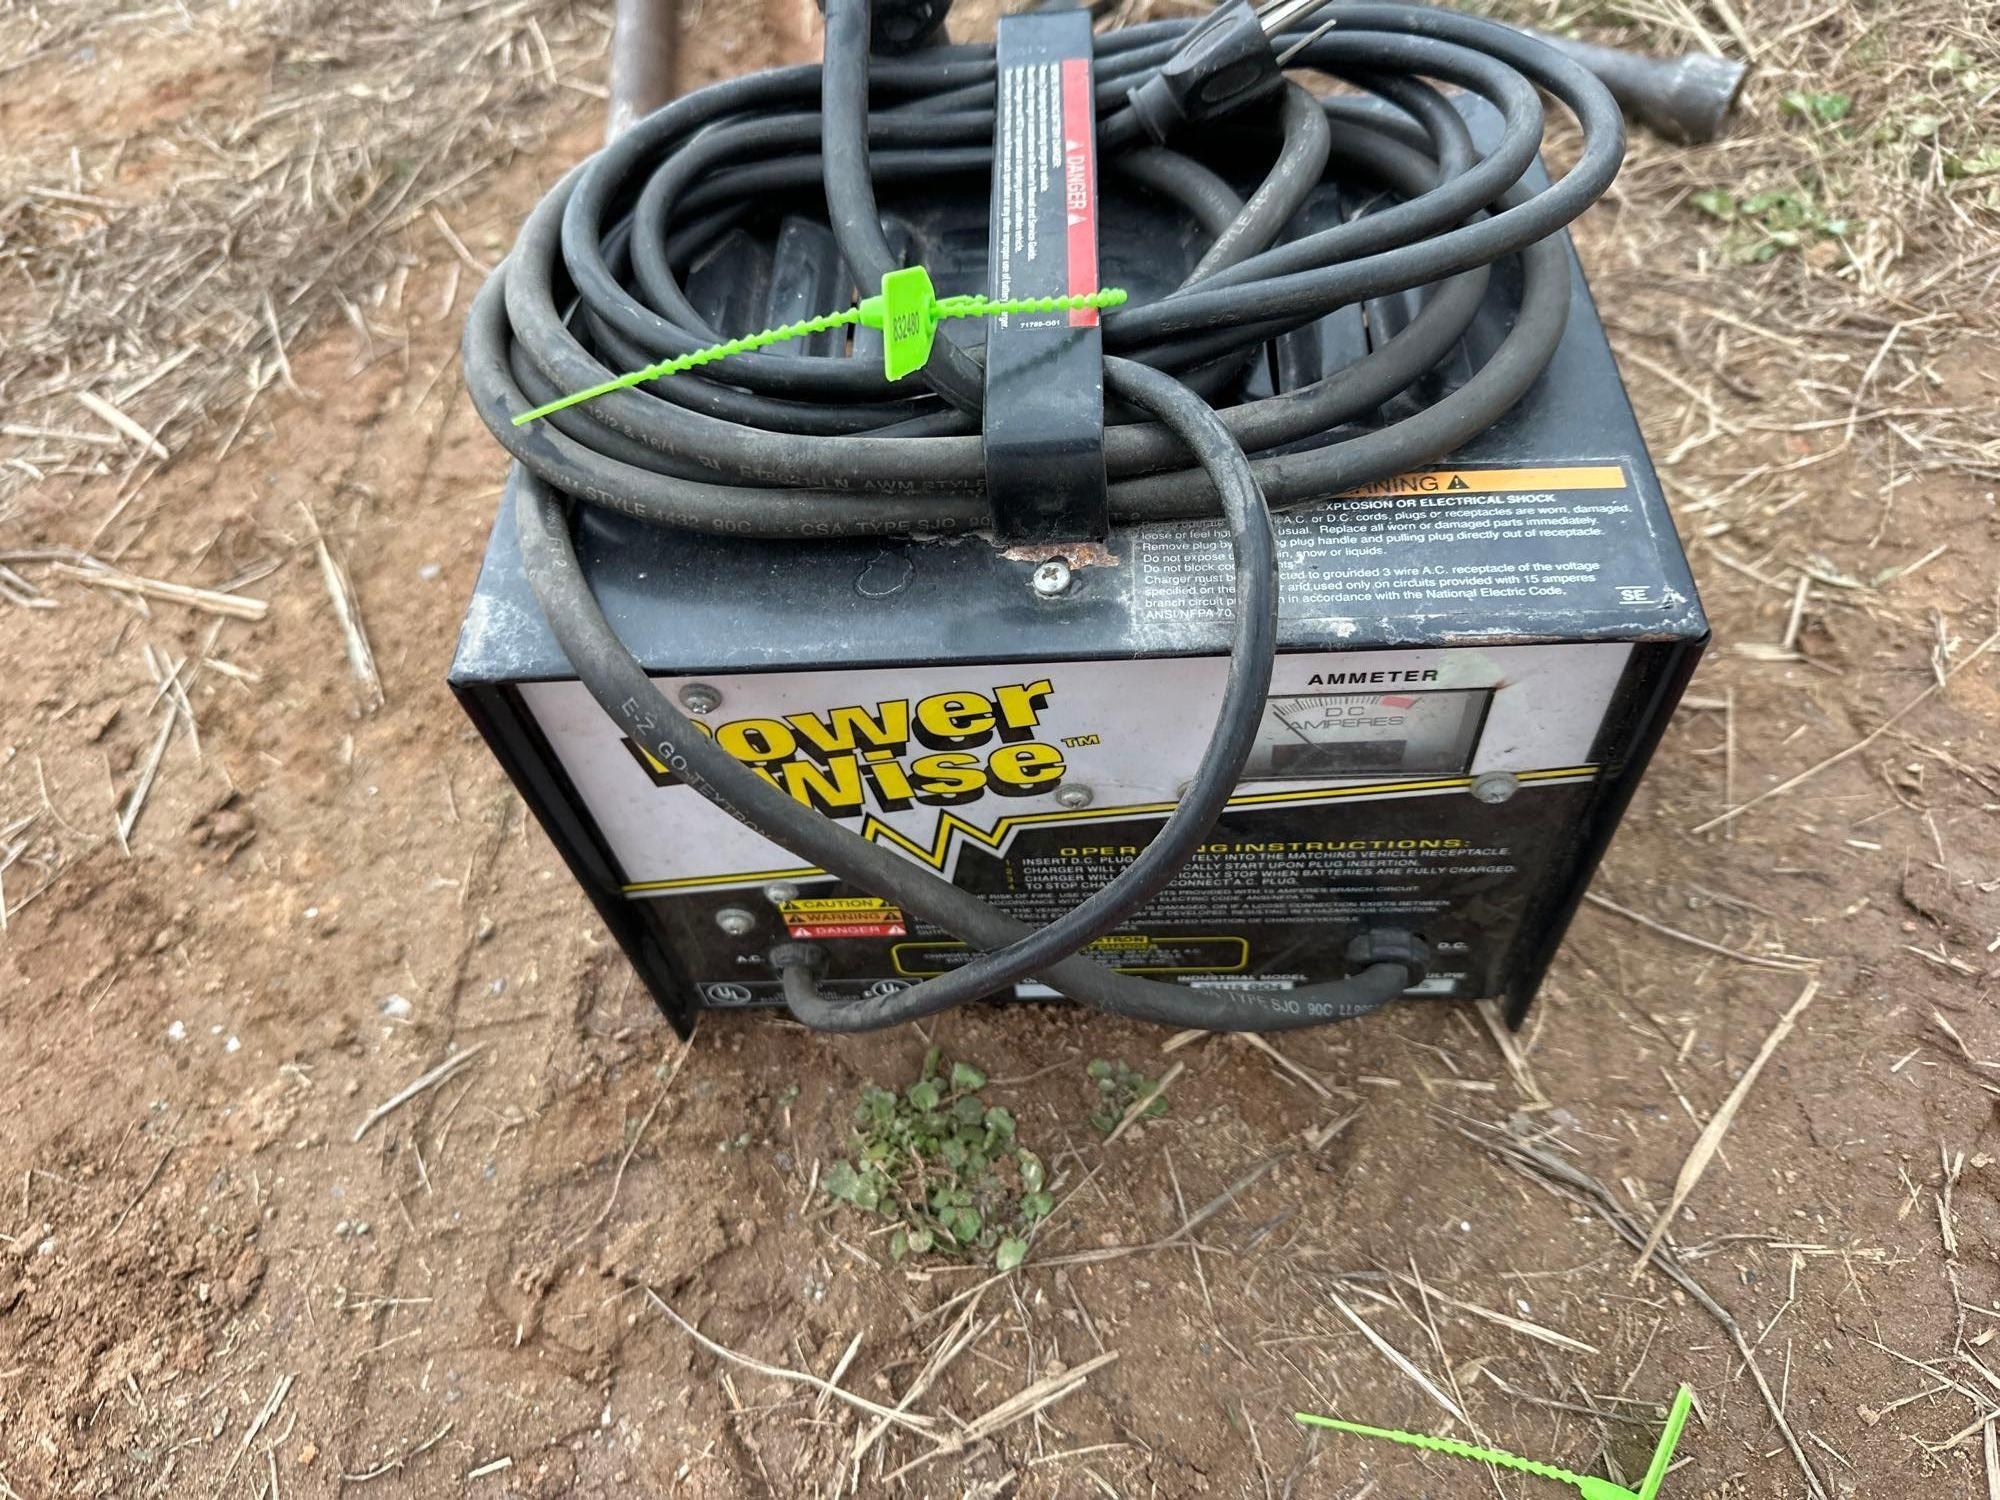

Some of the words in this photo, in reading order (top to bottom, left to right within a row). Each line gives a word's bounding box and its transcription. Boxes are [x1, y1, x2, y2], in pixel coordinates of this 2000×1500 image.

[1067, 156, 1086, 211] DANGER
[1397, 499, 1416, 508] OR
[1420, 496, 1504, 508] ELECTRICAL
[1507, 494, 1556, 504] SHOCK
[585, 487, 646, 515] STYLE
[800, 521, 842, 535] CSA
[856, 519, 911, 533] TYPE
[1284, 516, 1307, 524] A.C.
[1311, 515, 1323, 523] or
[1327, 514, 1352, 522] D.C.
[1395, 511, 1426, 522] plugs
[1445, 507, 1513, 520] receptacles
[1515, 507, 1535, 515] are
[1142, 532, 1171, 540] loose
[1176, 531, 1187, 539] or
[1189, 530, 1210, 539] feel
[1320, 524, 1366, 535] Replace
[1370, 523, 1384, 532] all
[1388, 523, 1416, 531] worn
[1419, 522, 1431, 530] or
[1434, 518, 1490, 530] damaged
[1494, 517, 1524, 528] parts
[1525, 515, 1599, 527] immediately.
[1143, 542, 1189, 551] Remove
[1192, 541, 1217, 552] plug
[1220, 540, 1233, 549] by
[1290, 536, 1315, 547] plug
[1318, 534, 1357, 545] handle
[1361, 534, 1383, 544] and
[1386, 533, 1425, 545] pulling
[1428, 532, 1453, 543] plug
[1457, 529, 1499, 540] directly
[1502, 529, 1522, 538] out
[1524, 528, 1536, 537] of
[1143, 554, 1159, 563] Do
[1162, 554, 1180, 562] not
[1184, 553, 1226, 563] expose
[1296, 549, 1327, 558] snow
[1330, 548, 1342, 556] or
[1346, 545, 1387, 557] liquids.
[1143, 564, 1159, 573] Do
[1163, 564, 1181, 572] not
[1184, 562, 1215, 572] block
[1145, 576, 1191, 587] Charger
[1195, 574, 1223, 584] must
[1309, 570, 1320, 579] to
[1323, 568, 1379, 581] grounded
[1382, 568, 1391, 576] 3
[1394, 567, 1419, 576] wire
[1422, 565, 1448, 575] A.C.
[1452, 563, 1515, 575] receptacle
[1518, 562, 1530, 572] of
[1533, 562, 1552, 572] the
[1555, 561, 1600, 572] voltage
[1145, 586, 1196, 597] specified
[1199, 586, 1214, 594] on
[1217, 585, 1236, 594] the
[1288, 581, 1310, 591] and
[1346, 580, 1371, 591] only
[1375, 580, 1390, 588] on
[1393, 578, 1436, 588] circuits
[1439, 575, 1492, 588] provided
[1495, 574, 1520, 584] with
[1524, 574, 1540, 584] 15
[1542, 574, 1596, 586] amperes
[1145, 598, 1185, 608] branch
[1189, 598, 1223, 607] circuit
[1288, 594, 1298, 603] in
[1302, 592, 1371, 603] accordance
[1375, 591, 1400, 601] with
[1403, 590, 1423, 600] the
[1426, 588, 1477, 599] National
[1481, 587, 1533, 598] Electric
[1621, 590, 1648, 601] SE
[1308, 670, 1438, 686] AMMETER
[1287, 716, 1404, 731] AMPERES
[621, 697, 658, 736] E-Z
[658, 741, 687, 771] GO
[1063, 735, 1099, 749] TM
[748, 741, 1067, 816] Wise
[1235, 839, 1471, 853] INSTRUCTIONS:
[1022, 857, 1067, 866] INSERT
[1071, 857, 1097, 865] D.C.
[1100, 856, 1135, 864] PLUG
[1224, 853, 1255, 861] INTO
[1259, 852, 1284, 860] THE
[1287, 850, 1356, 860] MATCHING
[1361, 849, 1417, 858] VEHICLE
[1023, 866, 1084, 875] CHARGER
[1088, 865, 1115, 873] WILL
[1225, 862, 1264, 870] START
[1268, 861, 1305, 869] UPON
[1308, 860, 1343, 868] PLUG
[1346, 859, 1420, 867] INSERTION.
[1025, 874, 1084, 882] CHARGER
[1261, 870, 1299, 878] WHEN
[1302, 868, 1372, 877] BATTERIES
[1376, 867, 1401, 875] ARE
[1406, 867, 1446, 875] FULLY
[1026, 882, 1042, 890] TO
[1045, 881, 1078, 890] STOP
[1233, 878, 1259, 886] A.C.
[804, 900, 873, 909] CAUTION
[806, 912, 881, 922] WARNING
[816, 926, 880, 935] DANGER
[1437, 941, 1468, 950] D.C.
[736, 954, 765, 963] A.C.
[1177, 974, 1256, 982] INDUSTRIAL
[1260, 973, 1309, 981] MODEL
[1308, 1002, 1333, 1016] 90C
